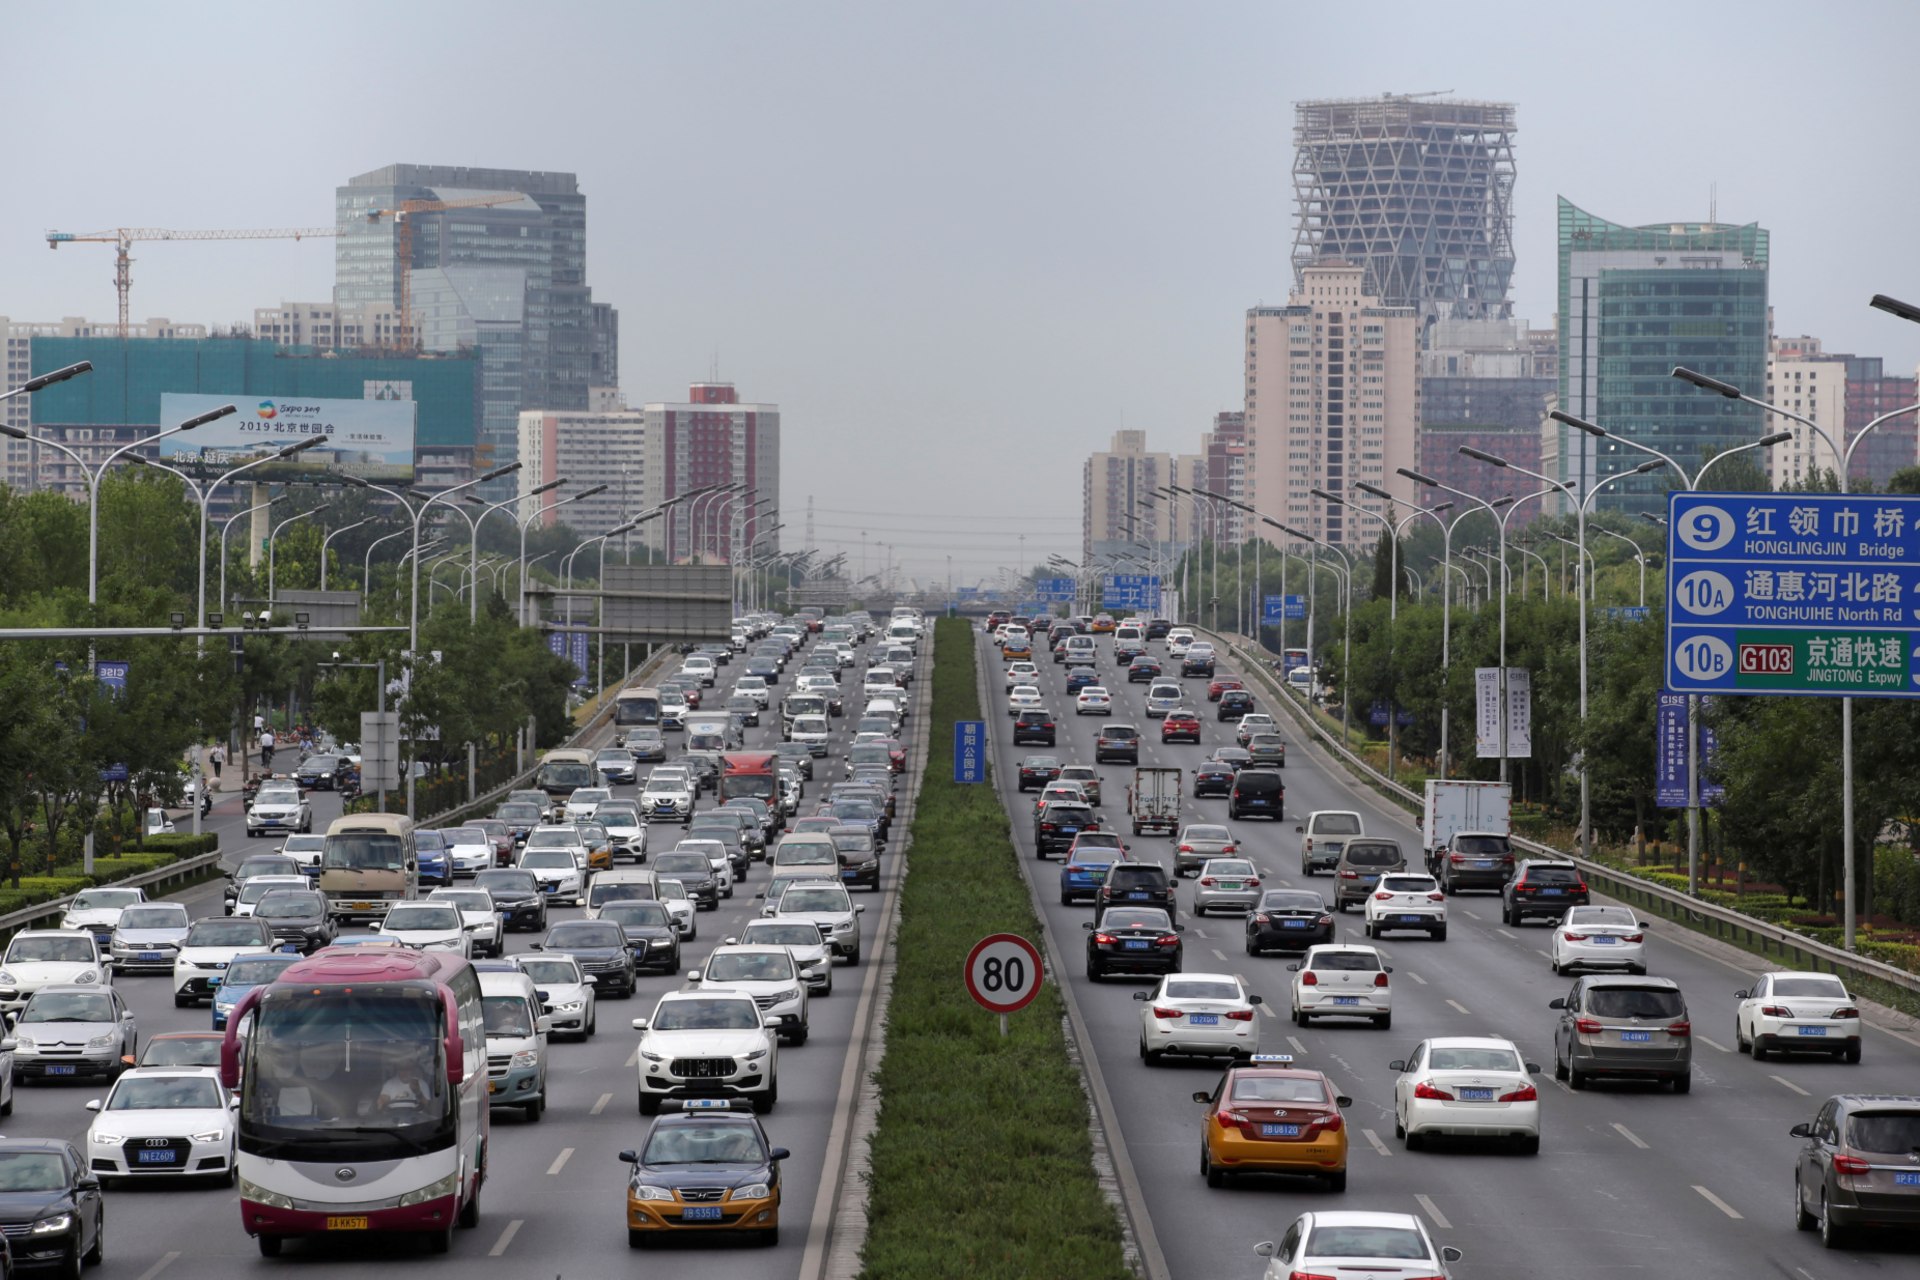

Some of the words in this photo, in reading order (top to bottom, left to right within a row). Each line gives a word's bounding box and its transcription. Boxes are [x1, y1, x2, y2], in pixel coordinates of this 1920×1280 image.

[240, 421, 270, 431] 2019
[274, 422, 335, 434] 北京世园会
[1693, 514, 1720, 542] 9
[1746, 506, 1905, 538] 红领巾桥
[1745, 540, 1847, 556] HONGLINGJIN
[1859, 543, 1905, 559] Bridge
[1684, 578, 1725, 608] 10A
[1744, 570, 1903, 603] 通惠河北路
[1744, 605, 1834, 621] TONGHUIHE
[1838, 608, 1879, 622] North
[1883, 608, 1903, 622] Rd
[1684, 642, 1724, 673] 10B
[1742, 647, 1791, 671] G103
[1806, 636, 1902, 668] 京通快速
[1806, 669, 1863, 683] JINGTONG
[1868, 671, 1903, 687] Expwy
[1661, 695, 1685, 704] CISE
[964, 723, 976, 781] 朝阳公园桥
[983, 956, 1025, 992] 80
